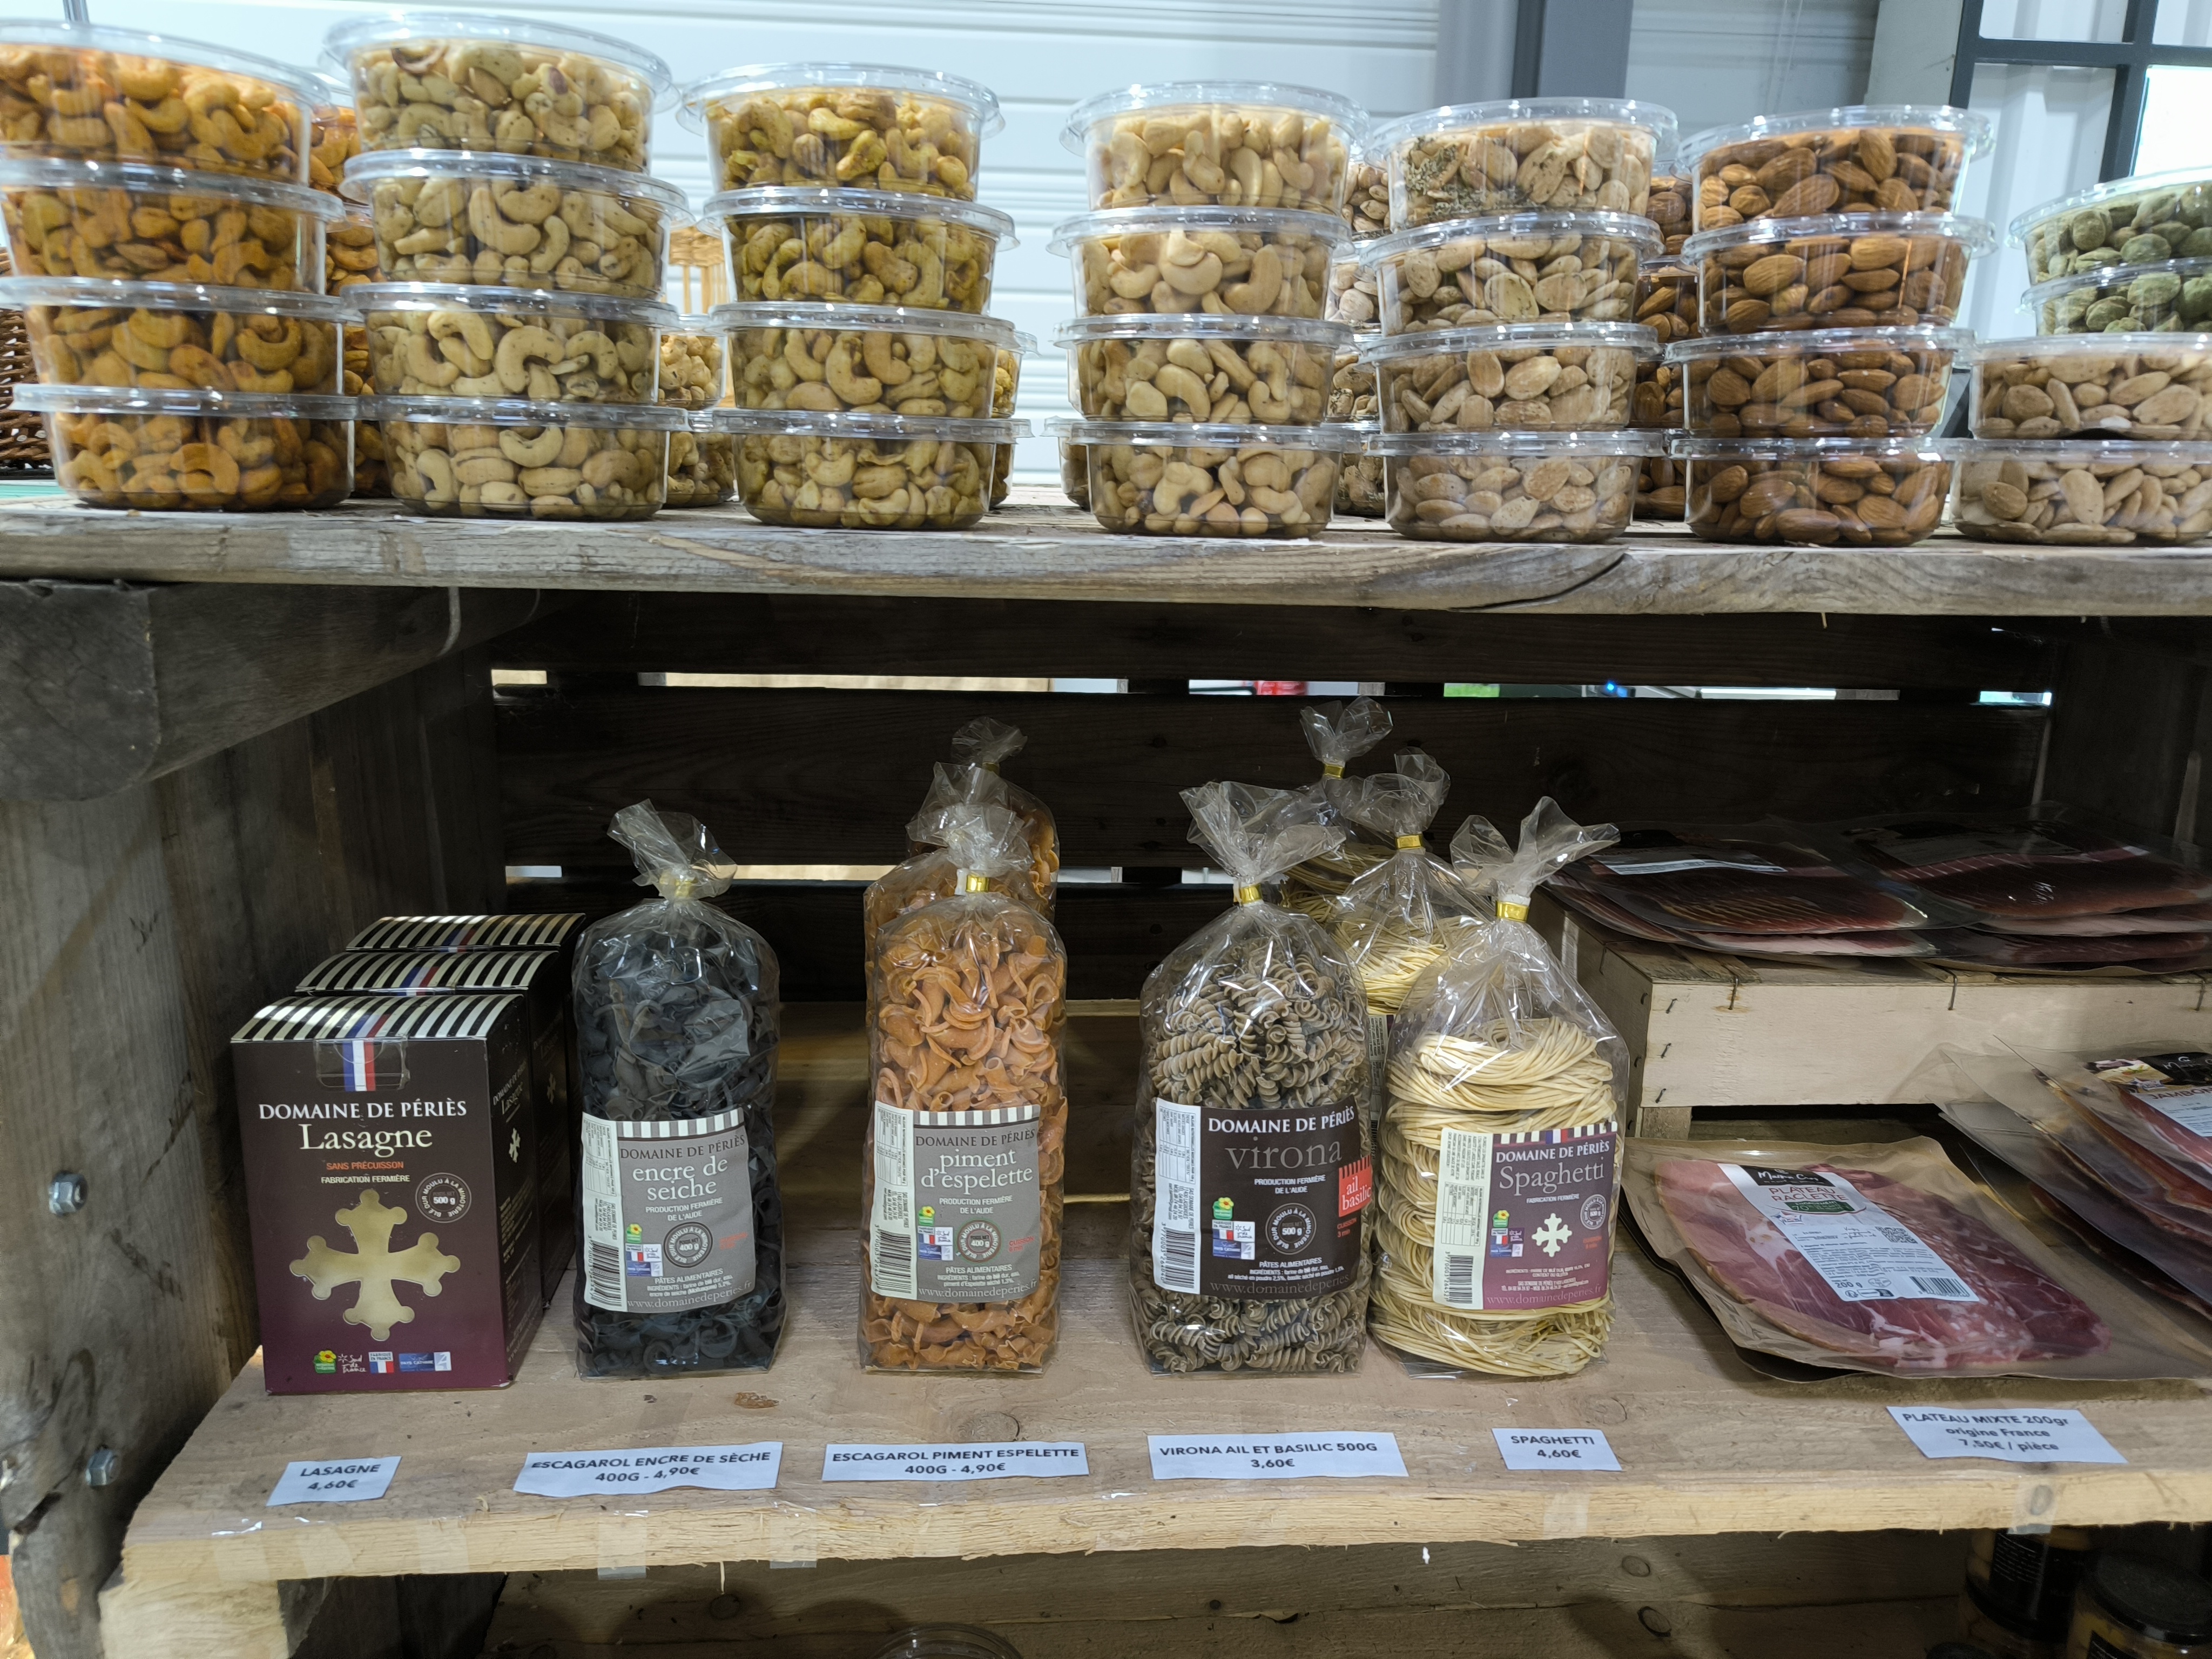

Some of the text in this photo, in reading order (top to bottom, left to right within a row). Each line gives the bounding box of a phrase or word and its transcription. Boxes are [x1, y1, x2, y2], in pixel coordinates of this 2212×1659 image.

[259, 1098, 467, 1120] DOMAINE DE PÉRIÈS
[1209, 1105, 1355, 1133] DOMAINE DE PÉRIÈS
[298, 1123, 433, 1157] Lasagne
[915, 1129, 1035, 1146] DOMAINE DE PÉRIÈS
[621, 1135, 745, 1159] DOMAINE DE PÉRIÈS
[1225, 1136, 1342, 1169] virona
[1496, 1140, 1610, 1163] DOMAINE DE PÉRIÈS
[327, 1161, 404, 1170] SANS PRÉCUISSON
[632, 1155, 728, 1181] encre de
[939, 1149, 1016, 1174] piment
[321, 1174, 410, 1184] FABRICATION FERMIÈRE
[921, 1168, 1033, 1195] d'espelette
[1499, 1156, 1604, 1196] Spaghetti
[423, 1178, 443, 1195] MOULU
[648, 1178, 717, 1201] seiche
[1346, 1175, 1358, 1195] ail
[1769, 1186, 1836, 1195] PLATEAU
[433, 1196, 456, 1205] 500 g
[645, 1197, 723, 1213] PRODUCTION FERMIÈRE
[939, 1195, 1013, 1205] PRODUCTION FERMIÈRE
[1342, 1184, 1372, 1210] basilic
[1771, 1193, 1849, 1202] RACLETTE
[678, 1211, 703, 1220] L'AUDE
[1272, 1209, 1292, 1226] MOULU
[670, 1228, 689, 1243] MOULU
[961, 1223, 980, 1239] MOULU
[1282, 1227, 1303, 1236] 500 g
[946, 1264, 1013, 1274] PÂTES ALIMENTAIRES
[1259, 1260, 1279, 1268] PÂTES
[655, 1276, 676, 1285] PÂTES
[676, 1268, 724, 1284] ALIMENTAIRES
[627, 1280, 752, 1308] www.domainedeperies.fr
[919, 1278, 1037, 1298] www.domainedeperies.fr
[1902, 1412, 2070, 1427] PLATEAU MIXTE 200gr
[1510, 1435, 1595, 1445] SPAGHETTI
[1945, 1427, 2051, 1438] origine France
[832, 1448, 1080, 1462] ESCAGAROL PIMENT ESPELETTE
[1160, 1442, 1378, 1456] VIRONA AIL ET BASILIC 500G
[1537, 1449, 1582, 1459] 4,60€
[2017, 1442, 2060, 1453] pièce
[531, 1451, 772, 1469] ESCAGAROL ENCRE DE SÈCHE
[1251, 1458, 1295, 1469] 3,60€
[300, 1464, 381, 1476] LASAGNE
[595, 1472, 639, 1482] 400G
[653, 1466, 700, 1479] 4,90€
[905, 1465, 947, 1474] 400G
[960, 1462, 1006, 1475] 4,90€
[307, 1479, 359, 1491] 4,60€
